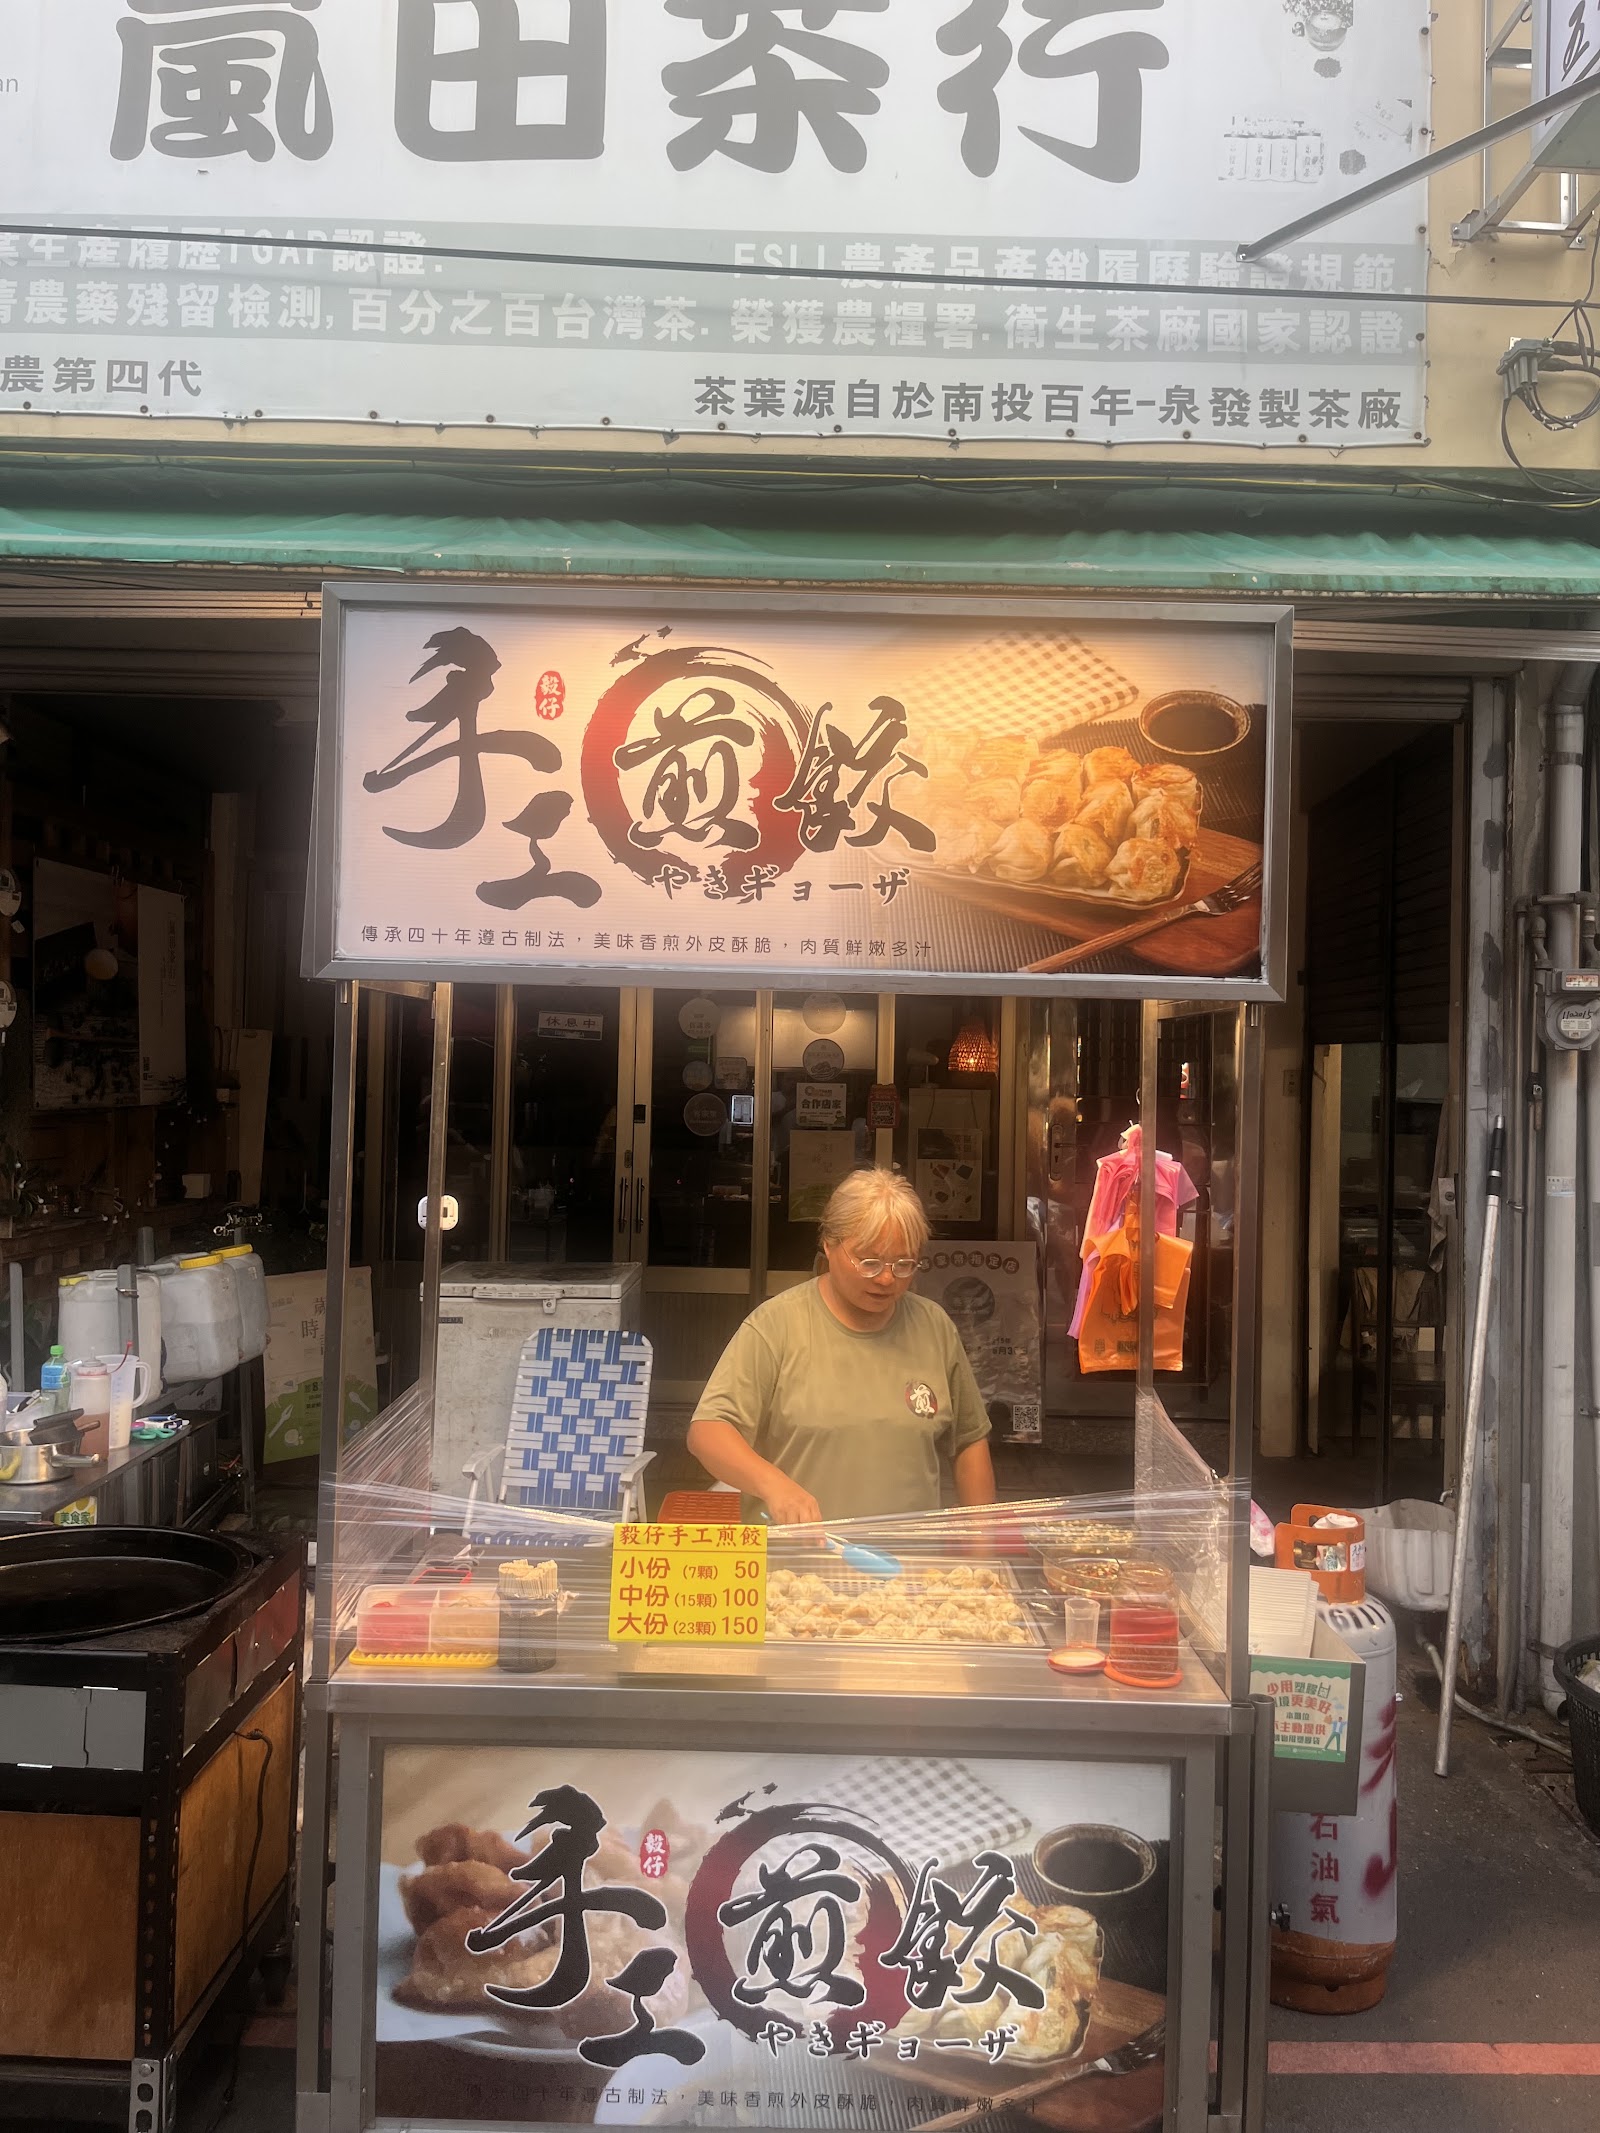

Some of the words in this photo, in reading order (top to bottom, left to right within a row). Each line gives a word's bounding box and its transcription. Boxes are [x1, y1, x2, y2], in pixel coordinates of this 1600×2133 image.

[655, 864, 910, 906] やきギョーザ
[545, 1015, 596, 1029] 休息中
[801, 1098, 842, 1110] 合作店家
[60, 1511, 91, 1525] 美食家
[620, 1525, 762, 1548] 毅仔手工煎餃
[619, 1556, 671, 1579] 小份
[682, 1565, 719, 1580] (7顆)
[734, 1560, 760, 1579] 50
[619, 1584, 670, 1607] 中份
[674, 1593, 718, 1608] (15顆)
[722, 1588, 759, 1607] 100
[617, 1612, 669, 1635] 大份
[673, 1620, 717, 1636] (23顆)
[721, 1616, 759, 1635] 150
[757, 2019, 1021, 2062] やきギョーザ
